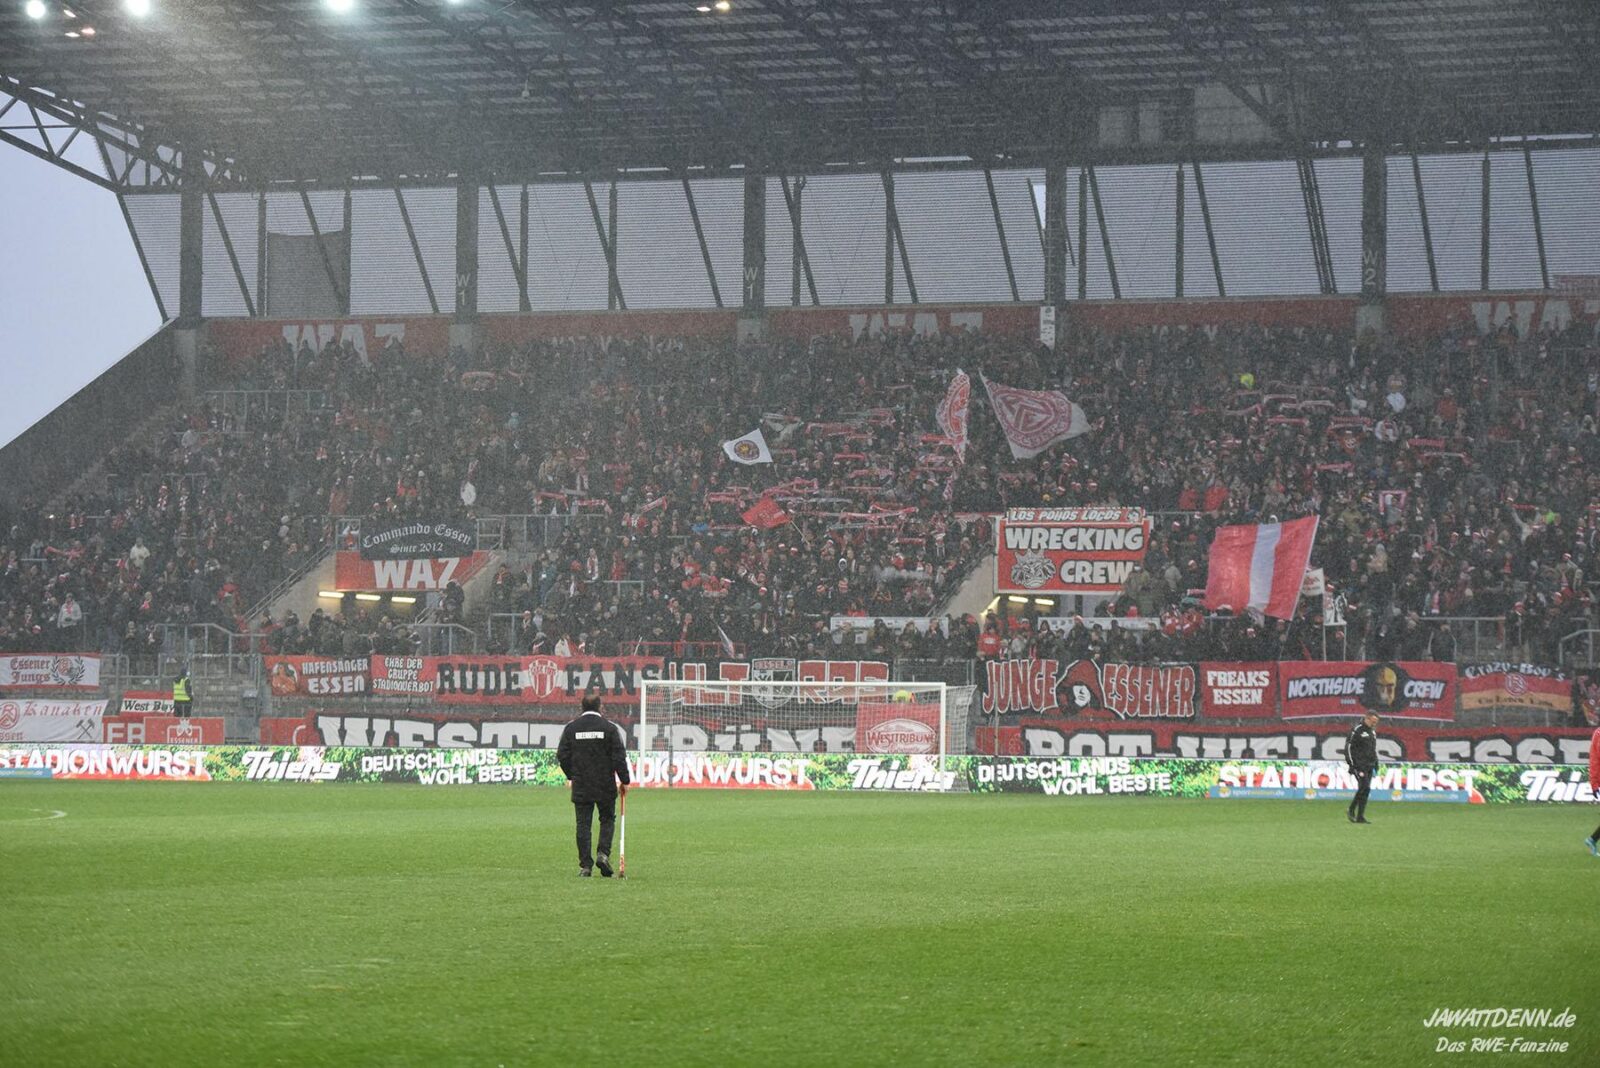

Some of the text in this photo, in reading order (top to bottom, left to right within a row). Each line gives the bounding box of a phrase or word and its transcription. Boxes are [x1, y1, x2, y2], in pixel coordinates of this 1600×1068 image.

[1011, 509, 1035, 521] LOS
[362, 523, 471, 548] Commando Essen
[1005, 527, 1143, 551] WRECKING
[390, 542, 443, 553] Since 2012
[373, 558, 459, 588] WAZ
[1060, 561, 1134, 584] CREW
[10, 658, 50, 670] Essener
[407, 657, 423, 668] DER
[11, 671, 50, 684] Jungs
[308, 675, 365, 694] ESSEN
[437, 662, 664, 696] RUDE FANS
[981, 659, 1196, 718] JUNGE ESSENER
[1207, 671, 1270, 688] FREAKS
[1288, 677, 1446, 699] NORTHSIDE CREW
[124, 700, 150, 711] West
[1213, 688, 1263, 705] ESSEN
[24, 701, 102, 717] Kanaken
[361, 749, 499, 773] DEUTSCHLANDS
[978, 757, 1130, 783] DEUTSCHLANDS
[419, 763, 536, 785] WOHL BESTE
[1041, 772, 1173, 795] WOHL BESTE
